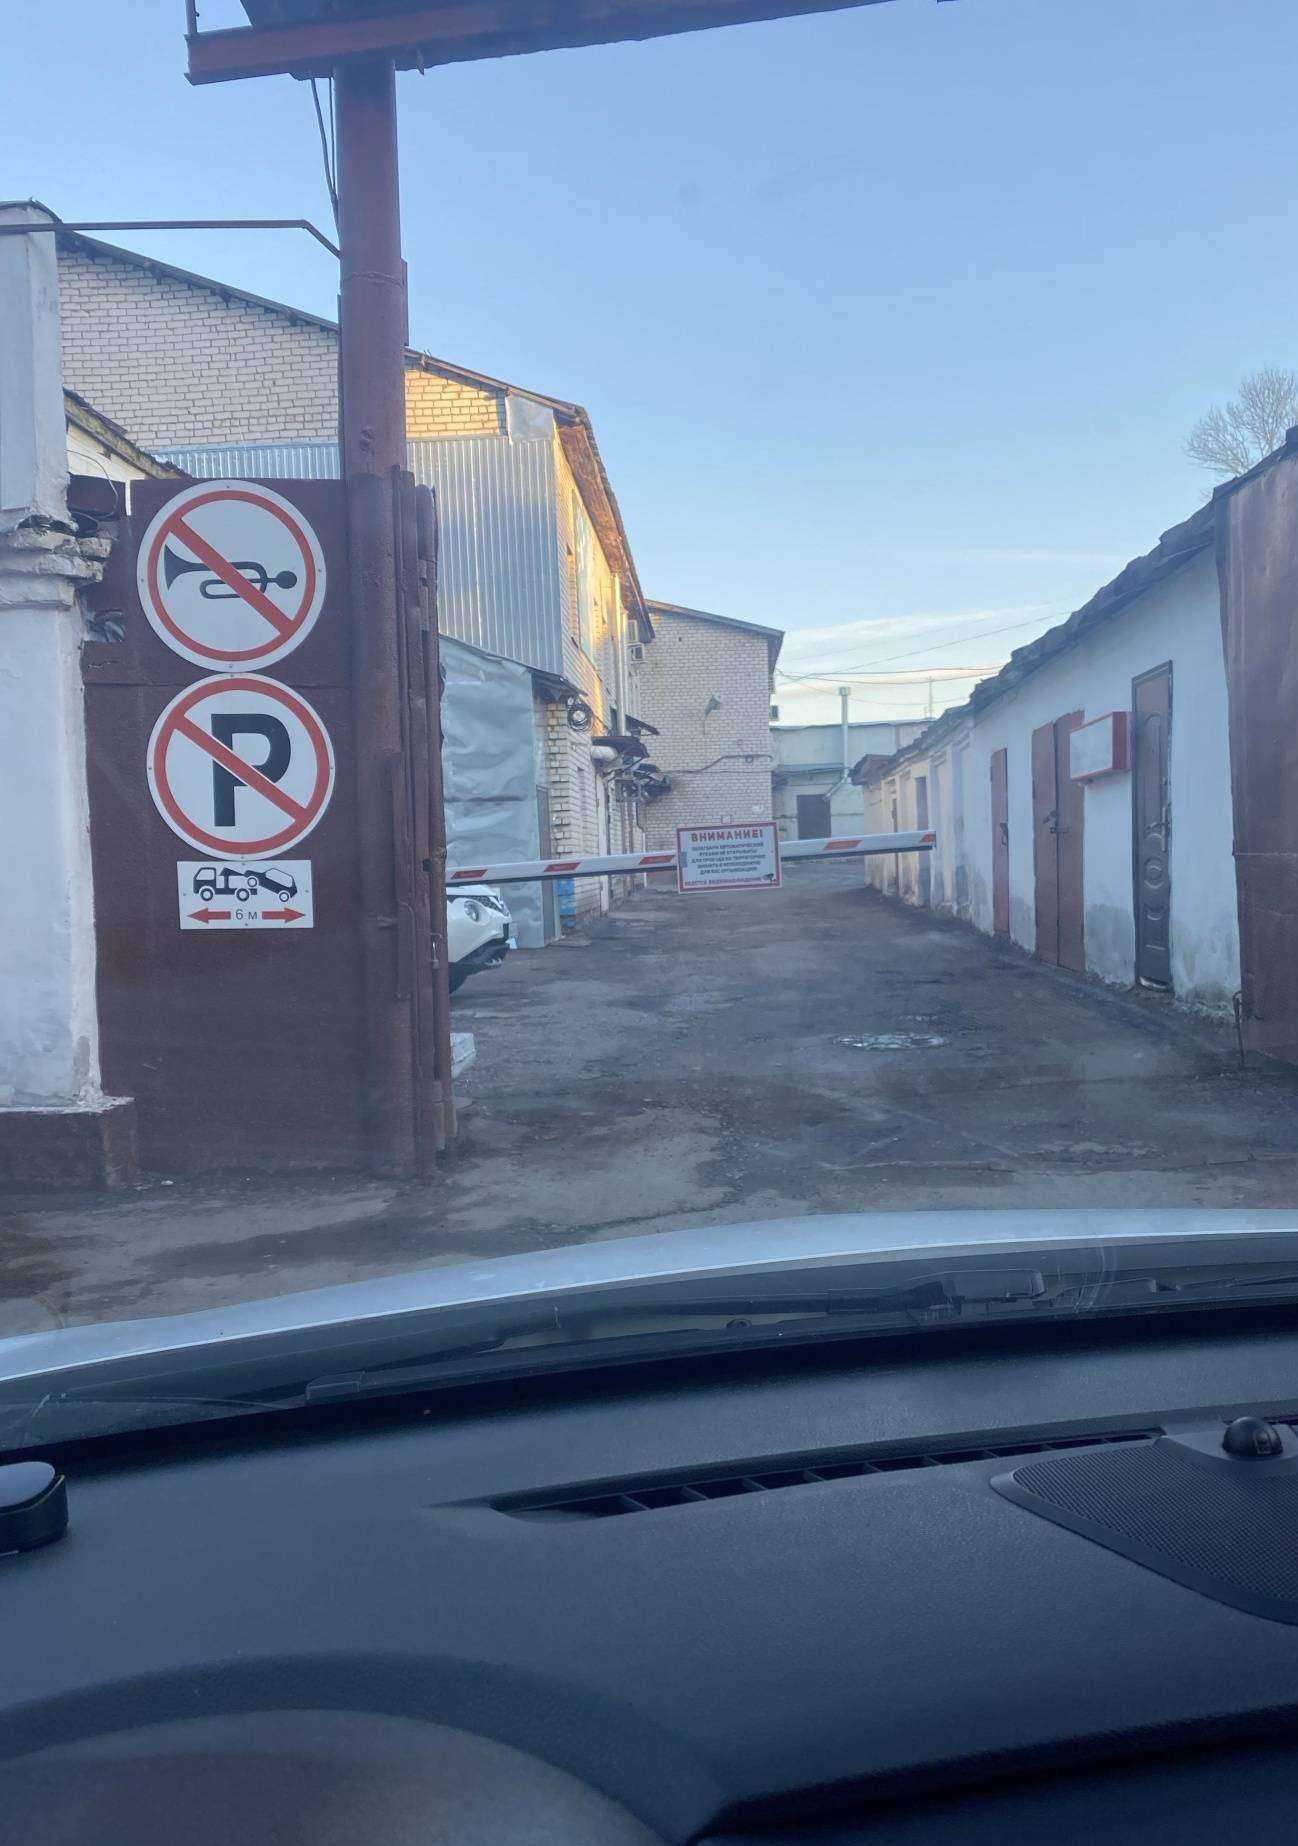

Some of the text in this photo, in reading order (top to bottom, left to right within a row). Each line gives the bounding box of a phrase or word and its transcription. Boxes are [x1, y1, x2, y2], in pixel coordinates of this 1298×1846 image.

[211, 714, 291, 826] P
[691, 828, 763, 842] ВНИМАНИЕ!
[235, 908, 244, 920] 6
